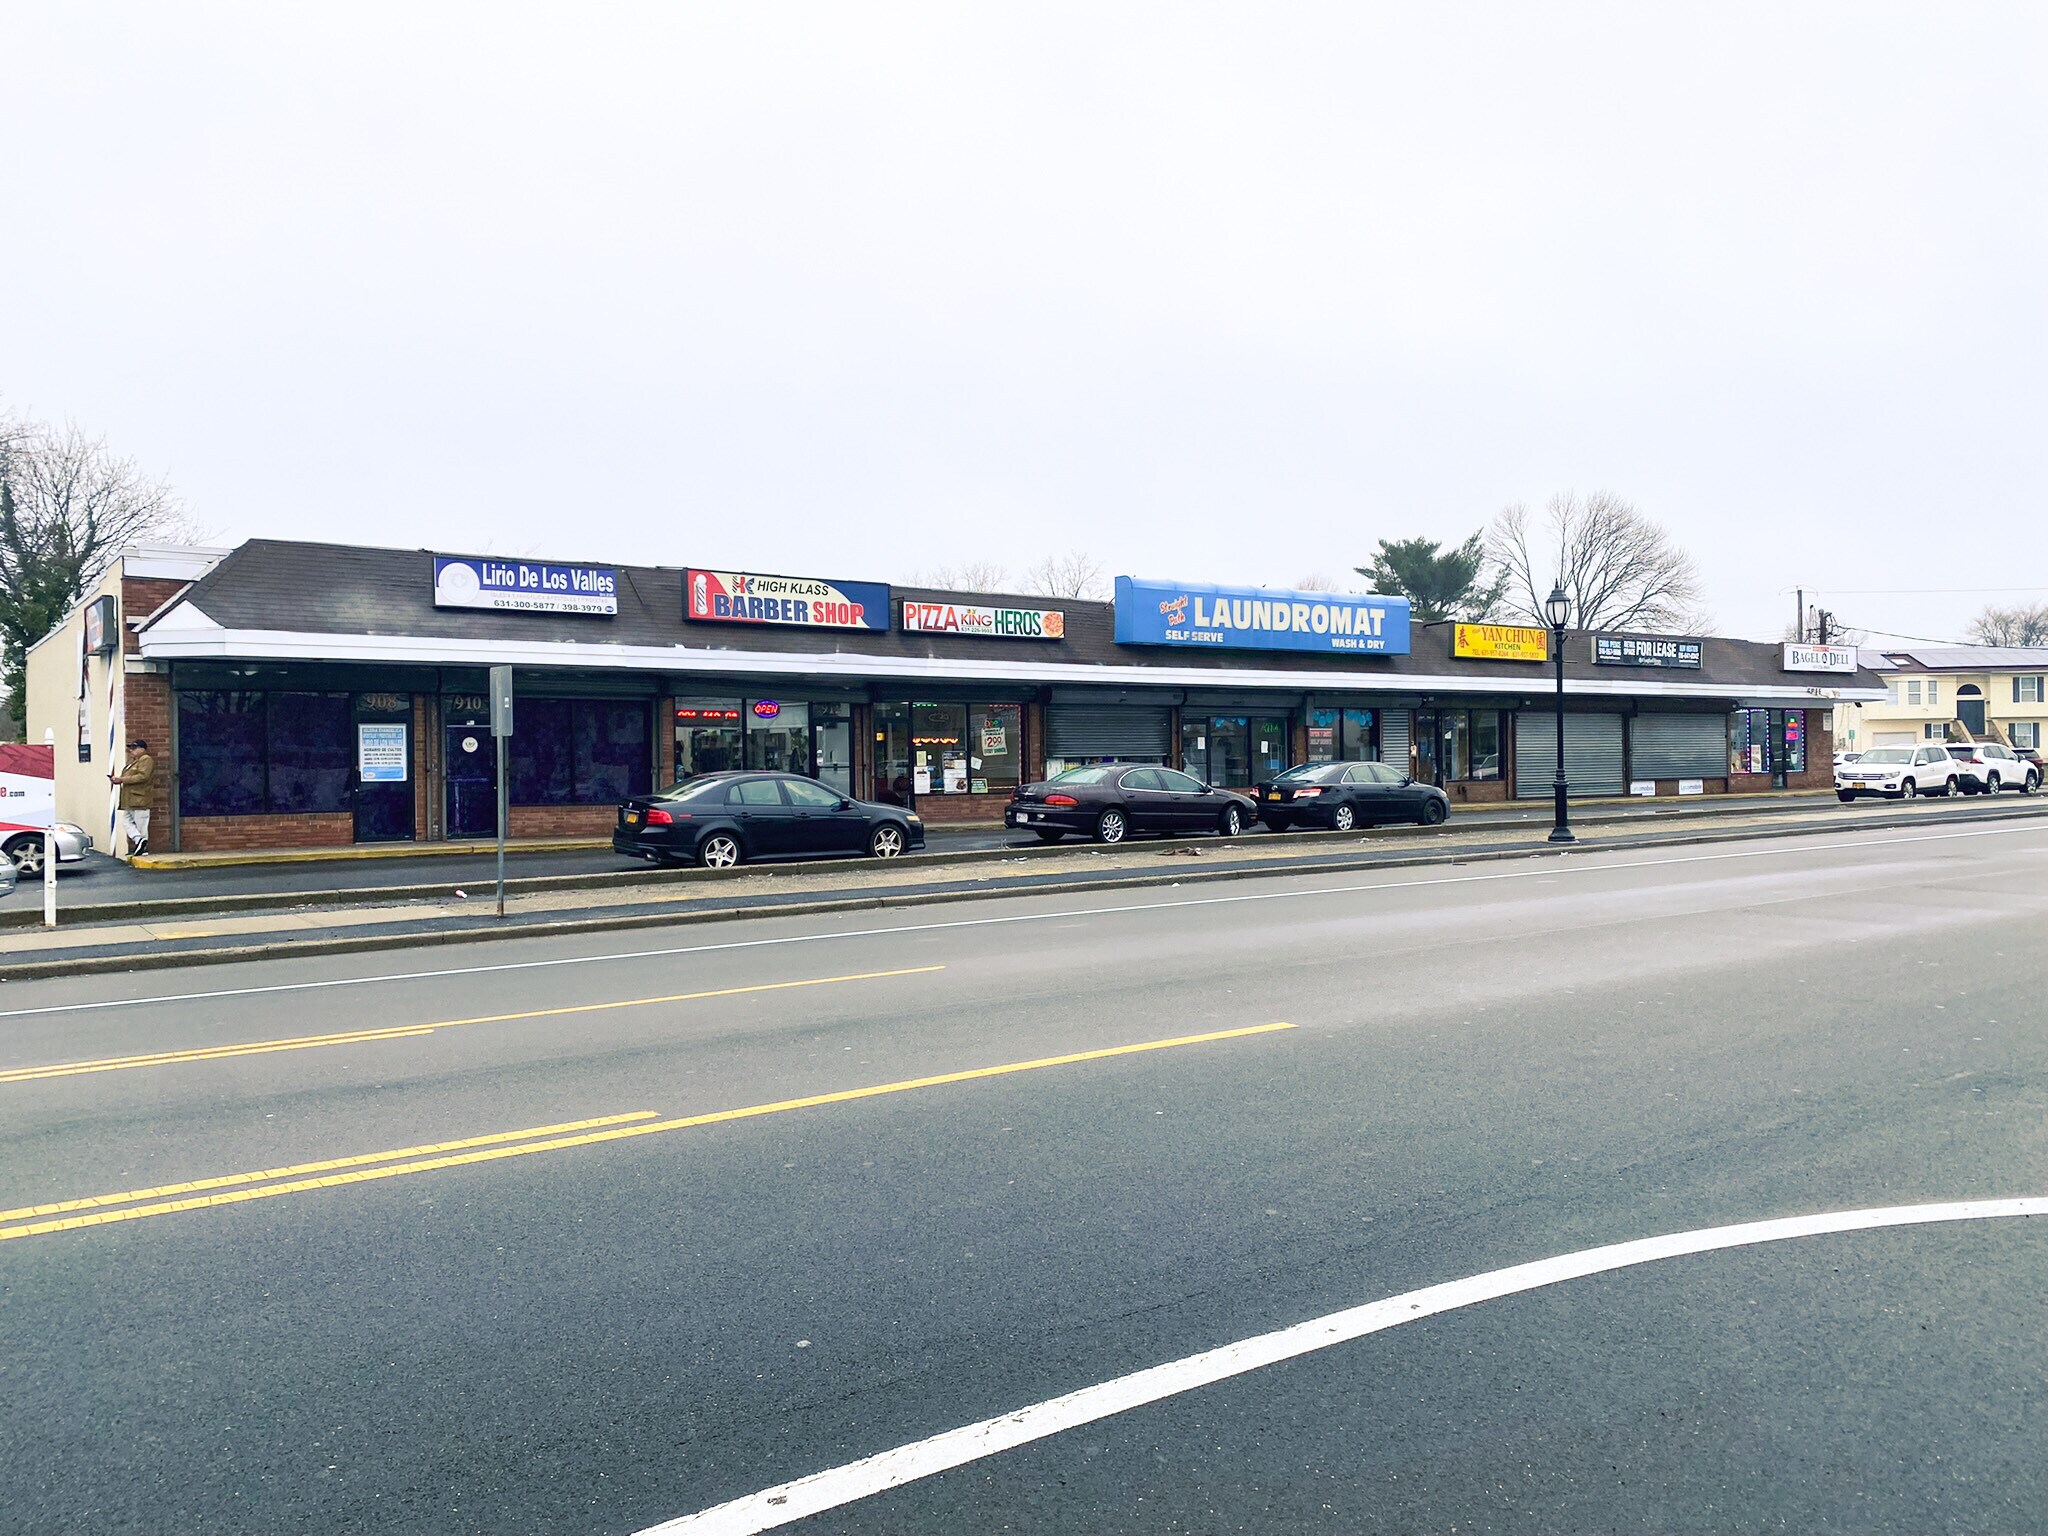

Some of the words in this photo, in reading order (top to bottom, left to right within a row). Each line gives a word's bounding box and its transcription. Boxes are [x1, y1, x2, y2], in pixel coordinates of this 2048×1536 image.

[482, 563, 515, 587] Lirio
[519, 566, 538, 588] De
[543, 567, 568, 590] Los
[571, 569, 614, 593] Valles
[757, 580, 787, 593] HIGH
[790, 583, 829, 596] KLASS
[494, 600, 555, 610] 631-300-5877
[562, 603, 602, 612] 398-3979
[714, 594, 809, 622] BARBER
[812, 601, 865, 625] SHOP
[905, 604, 960, 631] PIZZA
[961, 613, 993, 627] KING
[994, 610, 1042, 636] HEROS
[1194, 597, 1385, 637] LAUNDROMAT
[1165, 629, 1190, 640] SELF
[1191, 631, 1224, 642] SERVE
[1482, 627, 1503, 642] YAN
[1506, 628, 1535, 644] CHUN
[1332, 638, 1357, 649] WASH
[1359, 639, 1366, 649] &
[1367, 640, 1385, 650] DRY
[1636, 640, 1652, 656] FOR
[1653, 642, 1677, 658] LEASE
[1792, 651, 1821, 664] BAGEL
[1829, 652, 1849, 665] DELI
[366, 695, 397, 708] 908
[455, 696, 482, 710] 910
[754, 704, 779, 714] OPEN
